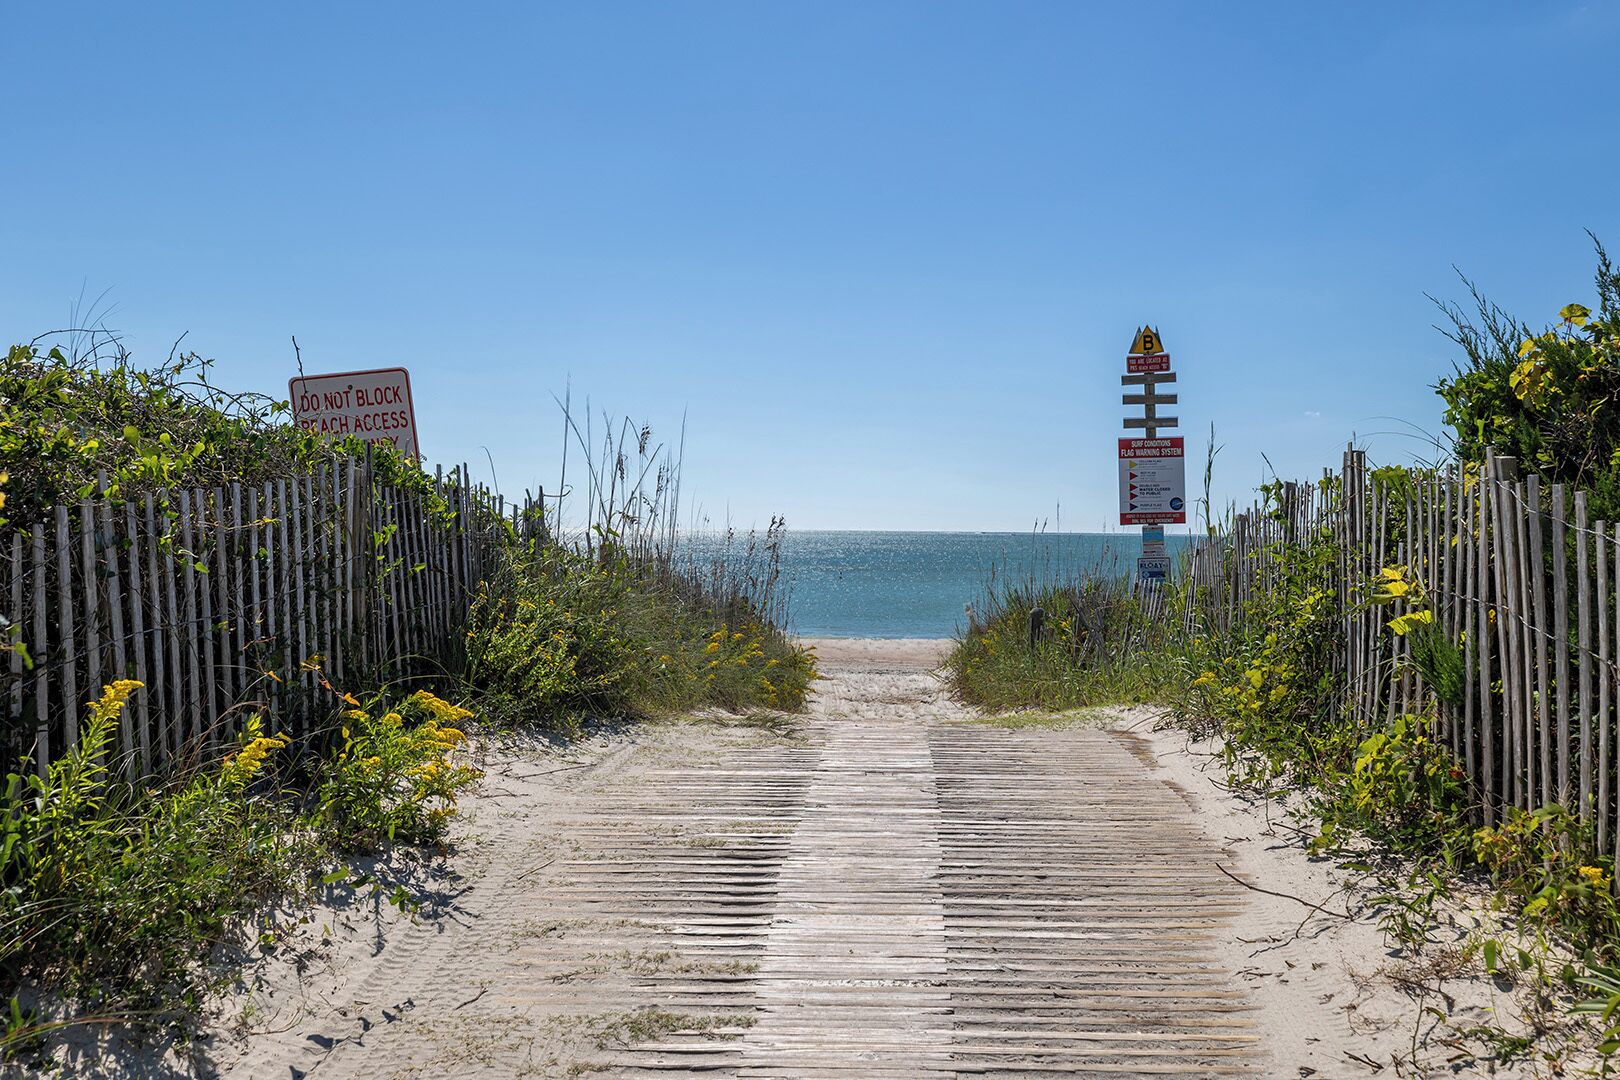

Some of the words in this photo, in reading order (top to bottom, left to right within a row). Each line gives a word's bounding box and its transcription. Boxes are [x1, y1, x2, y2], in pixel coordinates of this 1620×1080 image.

[1143, 335, 1154, 350] B
[300, 394, 320, 412] DO
[324, 390, 350, 410] NOT
[356, 386, 402, 407] BLOCK
[354, 411, 408, 432] ACCESS
[1136, 448, 1160, 456] WARNING
[1161, 448, 1182, 456] SYSTEM
